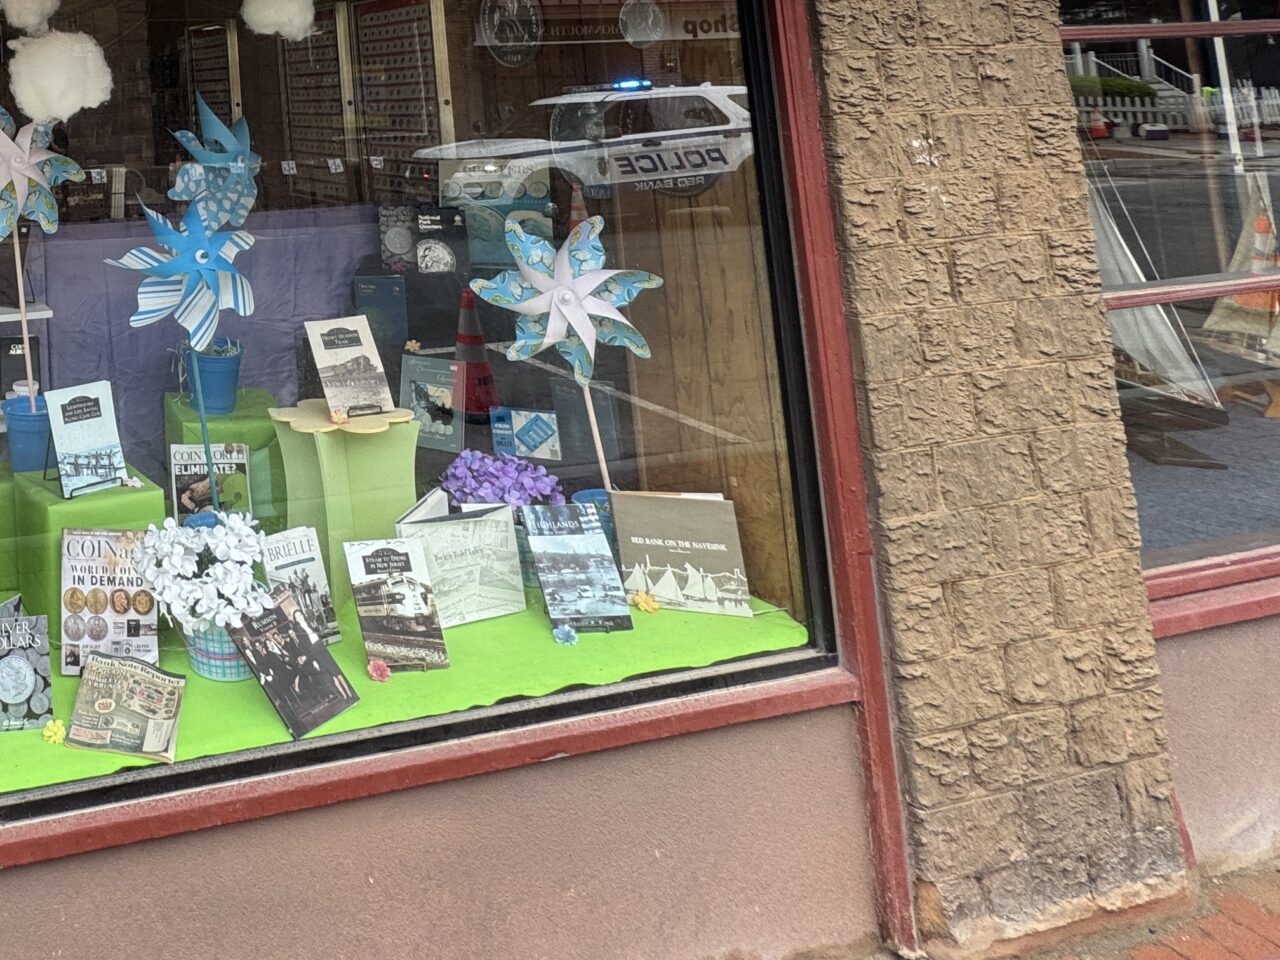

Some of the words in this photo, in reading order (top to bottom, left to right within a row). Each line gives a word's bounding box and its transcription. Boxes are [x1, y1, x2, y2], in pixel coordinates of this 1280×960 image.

[173, 450, 202, 461] COIN
[531, 520, 580, 529] HIGHLANDS
[630, 536, 645, 544] RED
[645, 538, 665, 546] BANK
[664, 539, 677, 547] ON
[677, 540, 691, 548] THE
[692, 542, 728, 552] NAVESINK
[267, 539, 317, 562] BRIELLE
[70, 564, 108, 575] WORLD
[113, 565, 139, 576] COIN
[72, 575, 85, 586] IN
[90, 575, 144, 587] DEMAND
[91, 655, 117, 667] Bank
[118, 661, 138, 671] Note
[139, 666, 182, 685] Reporter
